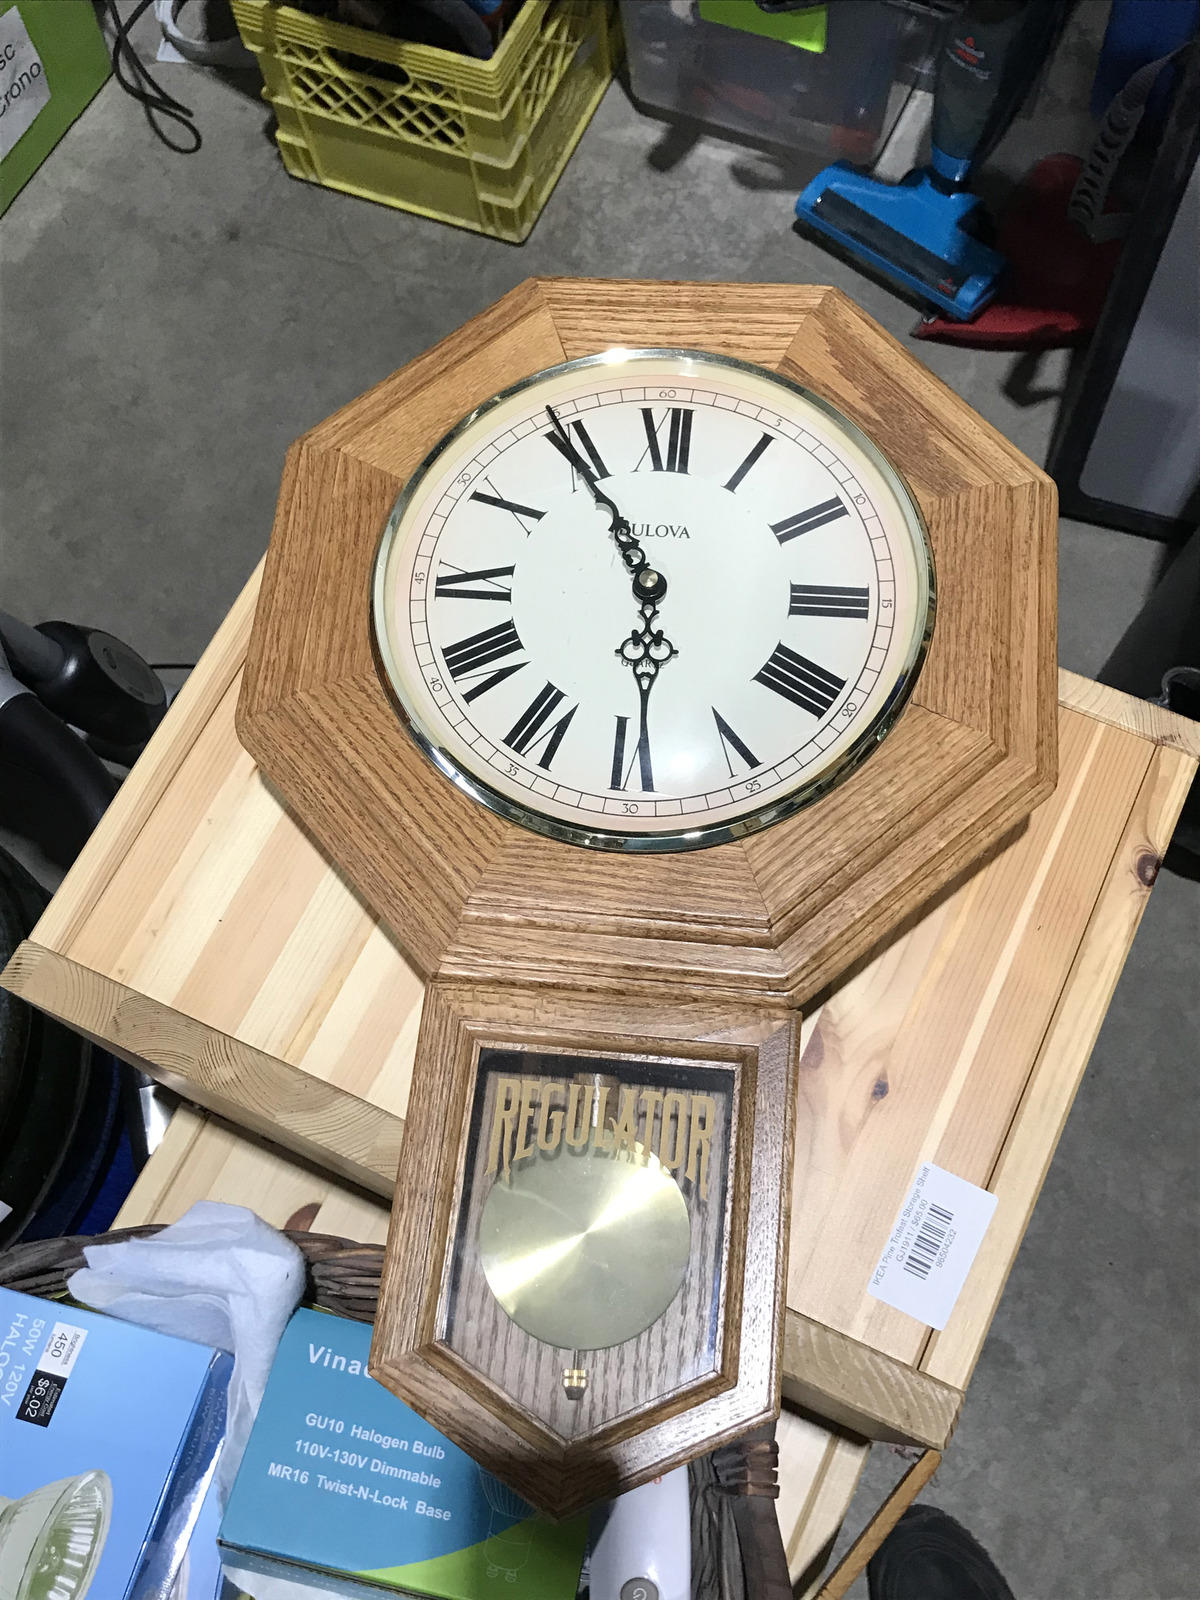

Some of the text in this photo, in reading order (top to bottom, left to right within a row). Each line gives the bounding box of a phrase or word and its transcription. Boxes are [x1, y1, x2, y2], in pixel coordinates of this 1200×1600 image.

[658, 388, 678, 399] 60
[775, 418, 782, 427] 5
[630, 407, 697, 475] XII
[457, 472, 472, 487] 50
[466, 474, 549, 538] X
[853, 492, 866, 505] 10
[414, 572, 425, 585] 45
[787, 579, 870, 623] III
[882, 598, 892, 609] 15
[440, 616, 532, 706] VIII
[430, 676, 443, 692] 40
[499, 679, 580, 772] VII
[841, 701, 858, 718] 20
[505, 764, 519, 777] 35
[744, 779, 762, 793] 25
[621, 802, 639, 814] 30
[484, 1078, 716, 1201] REGULATOR
[872, 1264, 887, 1286] IKEA
[903, 1187, 922, 1218] Storage
[50, 1332, 68, 1358] 450
[1, 1318, 46, 1406] 50W 120V
[25, 1378, 50, 1418] $6.02
[305, 1412, 446, 1460] GU10 Halogen Bulb
[295, 1439, 442, 1488] 110V-130V Dimmable
[267, 1462, 452, 1521] MR16 Twist-N-Lock Base
